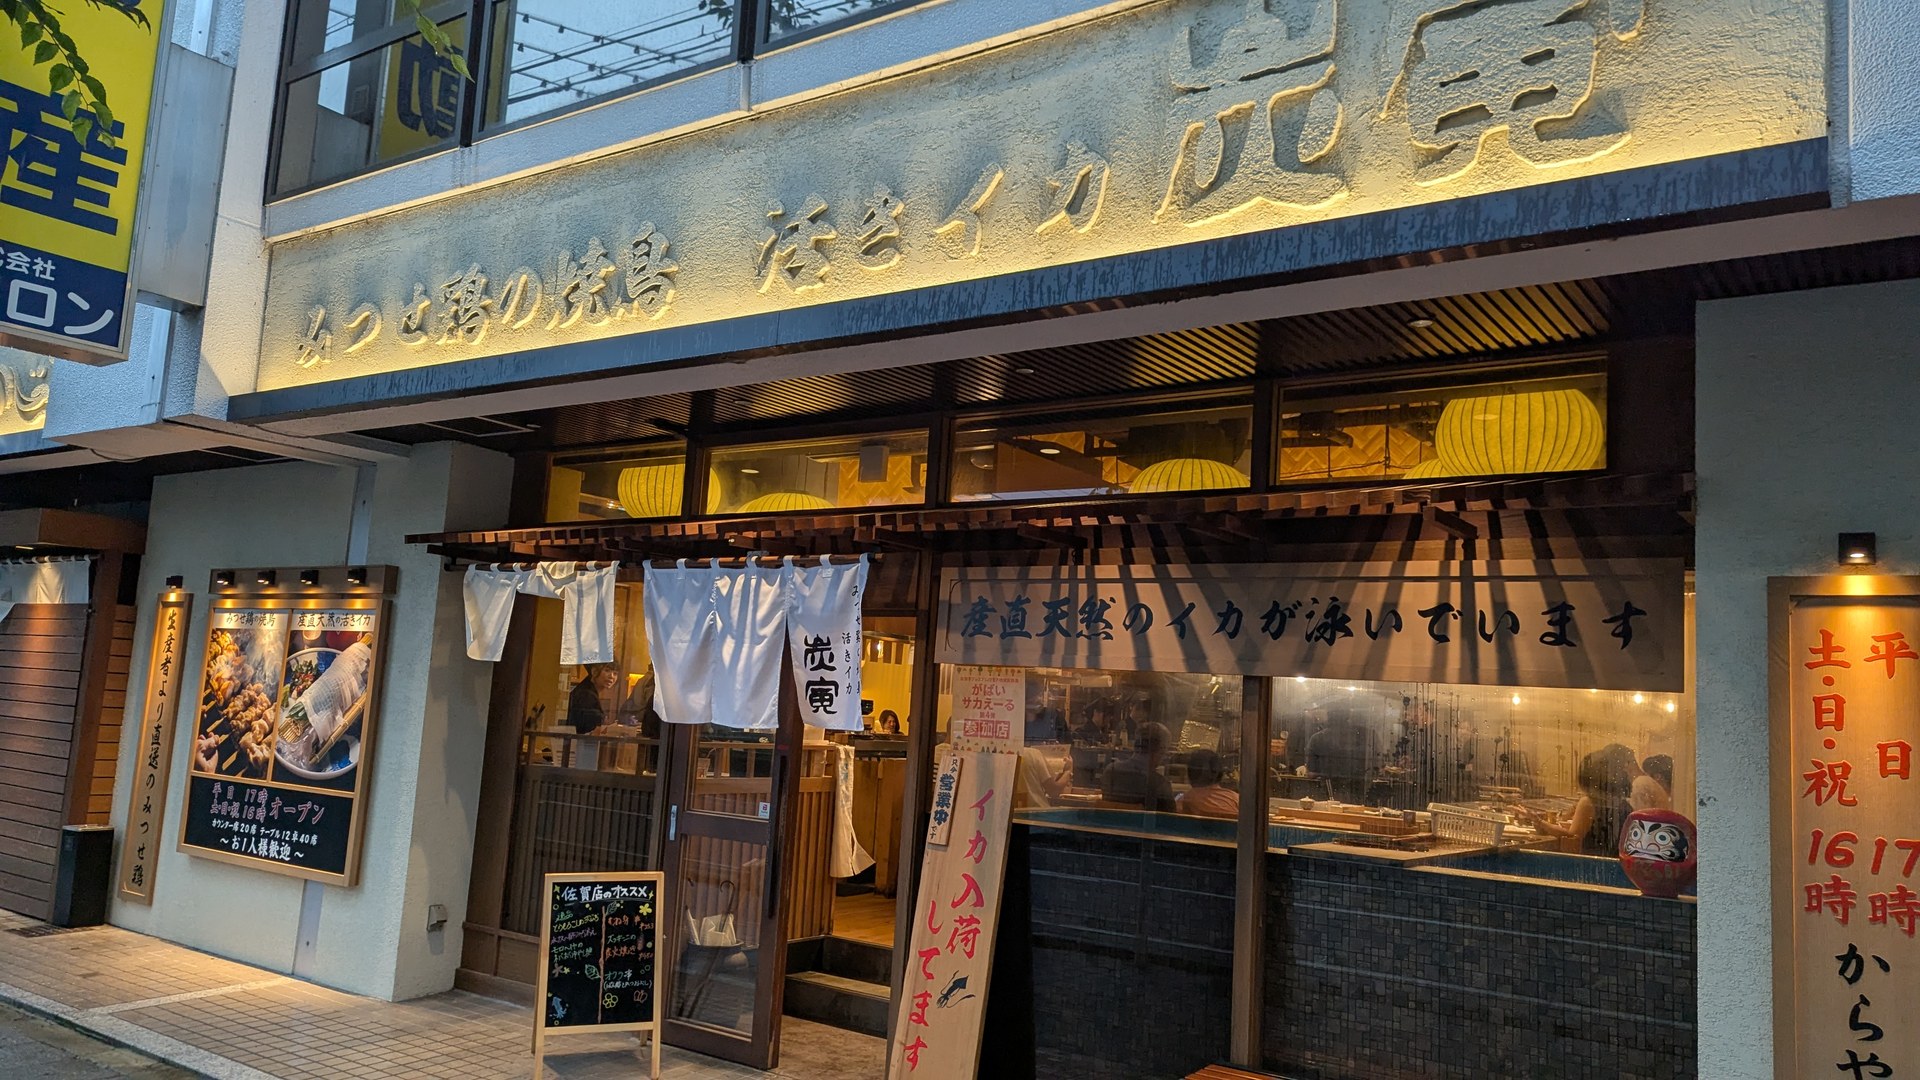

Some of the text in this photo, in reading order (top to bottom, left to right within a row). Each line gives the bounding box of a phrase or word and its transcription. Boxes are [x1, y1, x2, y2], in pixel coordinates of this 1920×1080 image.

[296, 221, 680, 369] みつせ鶏の焼鳥
[757, 140, 1110, 295] 活きイカ
[226, 612, 276, 627] みつせ鶏の焼鳥
[297, 611, 371, 628] 産直天然の活きイカ
[960, 593, 1648, 650] 産直天然のイカが泳いでいます
[842, 632, 853, 694] 活きイカ
[962, 697, 1015, 711] サカえーる
[972, 683, 1006, 697] がばい
[963, 719, 1011, 740] 参加店
[131, 609, 177, 887] 生産者より直送のみつせ鶏
[269, 797, 325, 825] オープン
[945, 789, 994, 959] イカ入荷
[561, 884, 648, 901] 佐賀店のオススメ
[903, 900, 943, 1072] してます
